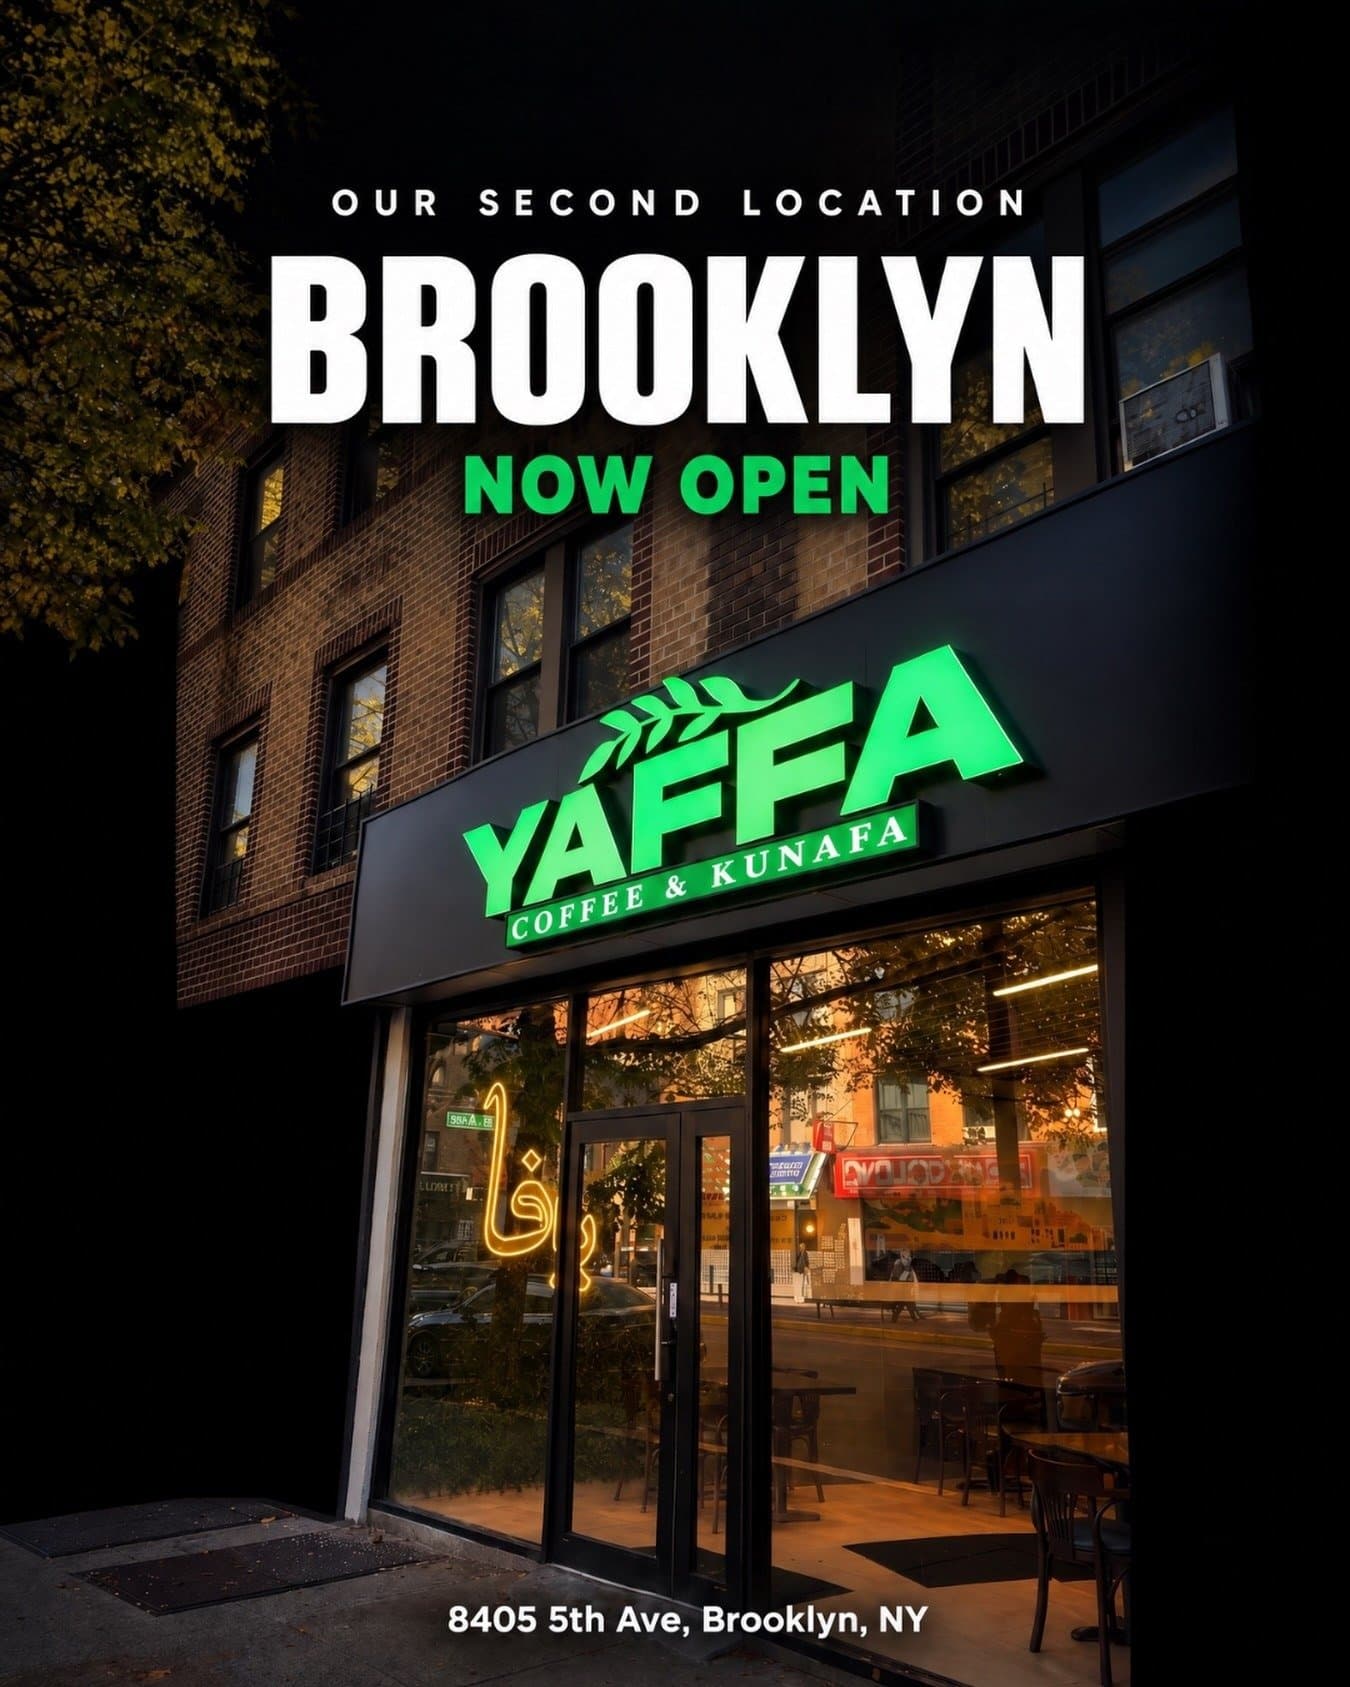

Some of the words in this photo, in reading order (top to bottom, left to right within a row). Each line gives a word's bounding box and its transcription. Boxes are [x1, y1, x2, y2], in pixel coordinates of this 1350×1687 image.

[462, 644, 1024, 918] YAFFA
[511, 883, 643, 941] COFFEE
[665, 875, 687, 900] &
[711, 815, 908, 889] KUNAFA
